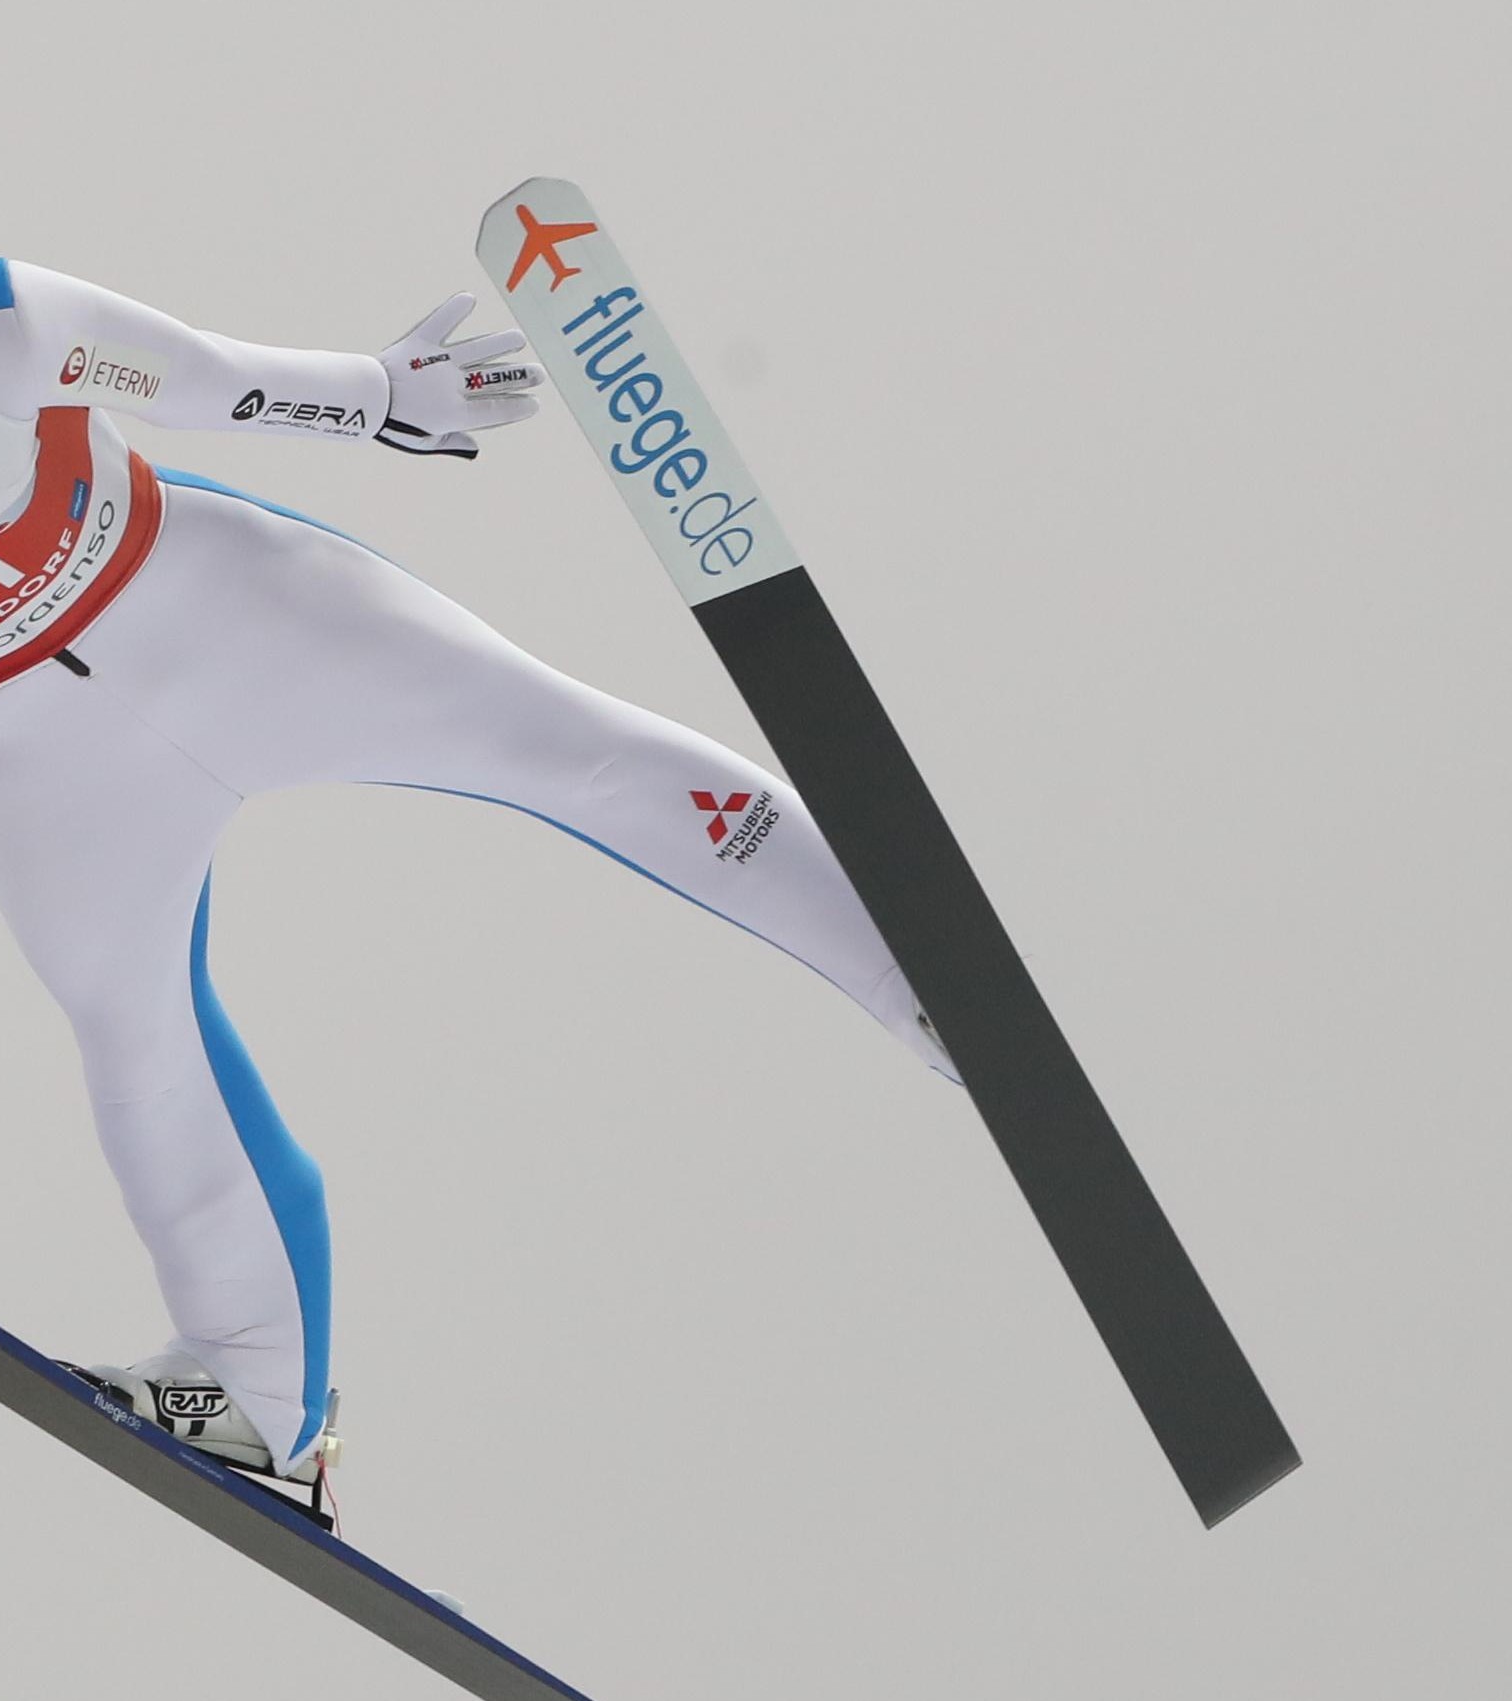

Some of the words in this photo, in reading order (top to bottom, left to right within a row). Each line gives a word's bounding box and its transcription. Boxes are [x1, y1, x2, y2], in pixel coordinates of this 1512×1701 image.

[92, 361, 161, 400] ETERNI
[263, 401, 366, 429] FIBRA
[323, 427, 360, 437] WEAR
[561, 286, 757, 575] fluege.de
[715, 791, 773, 862] MITSUBISHI
[735, 809, 780, 864] MOTORS
